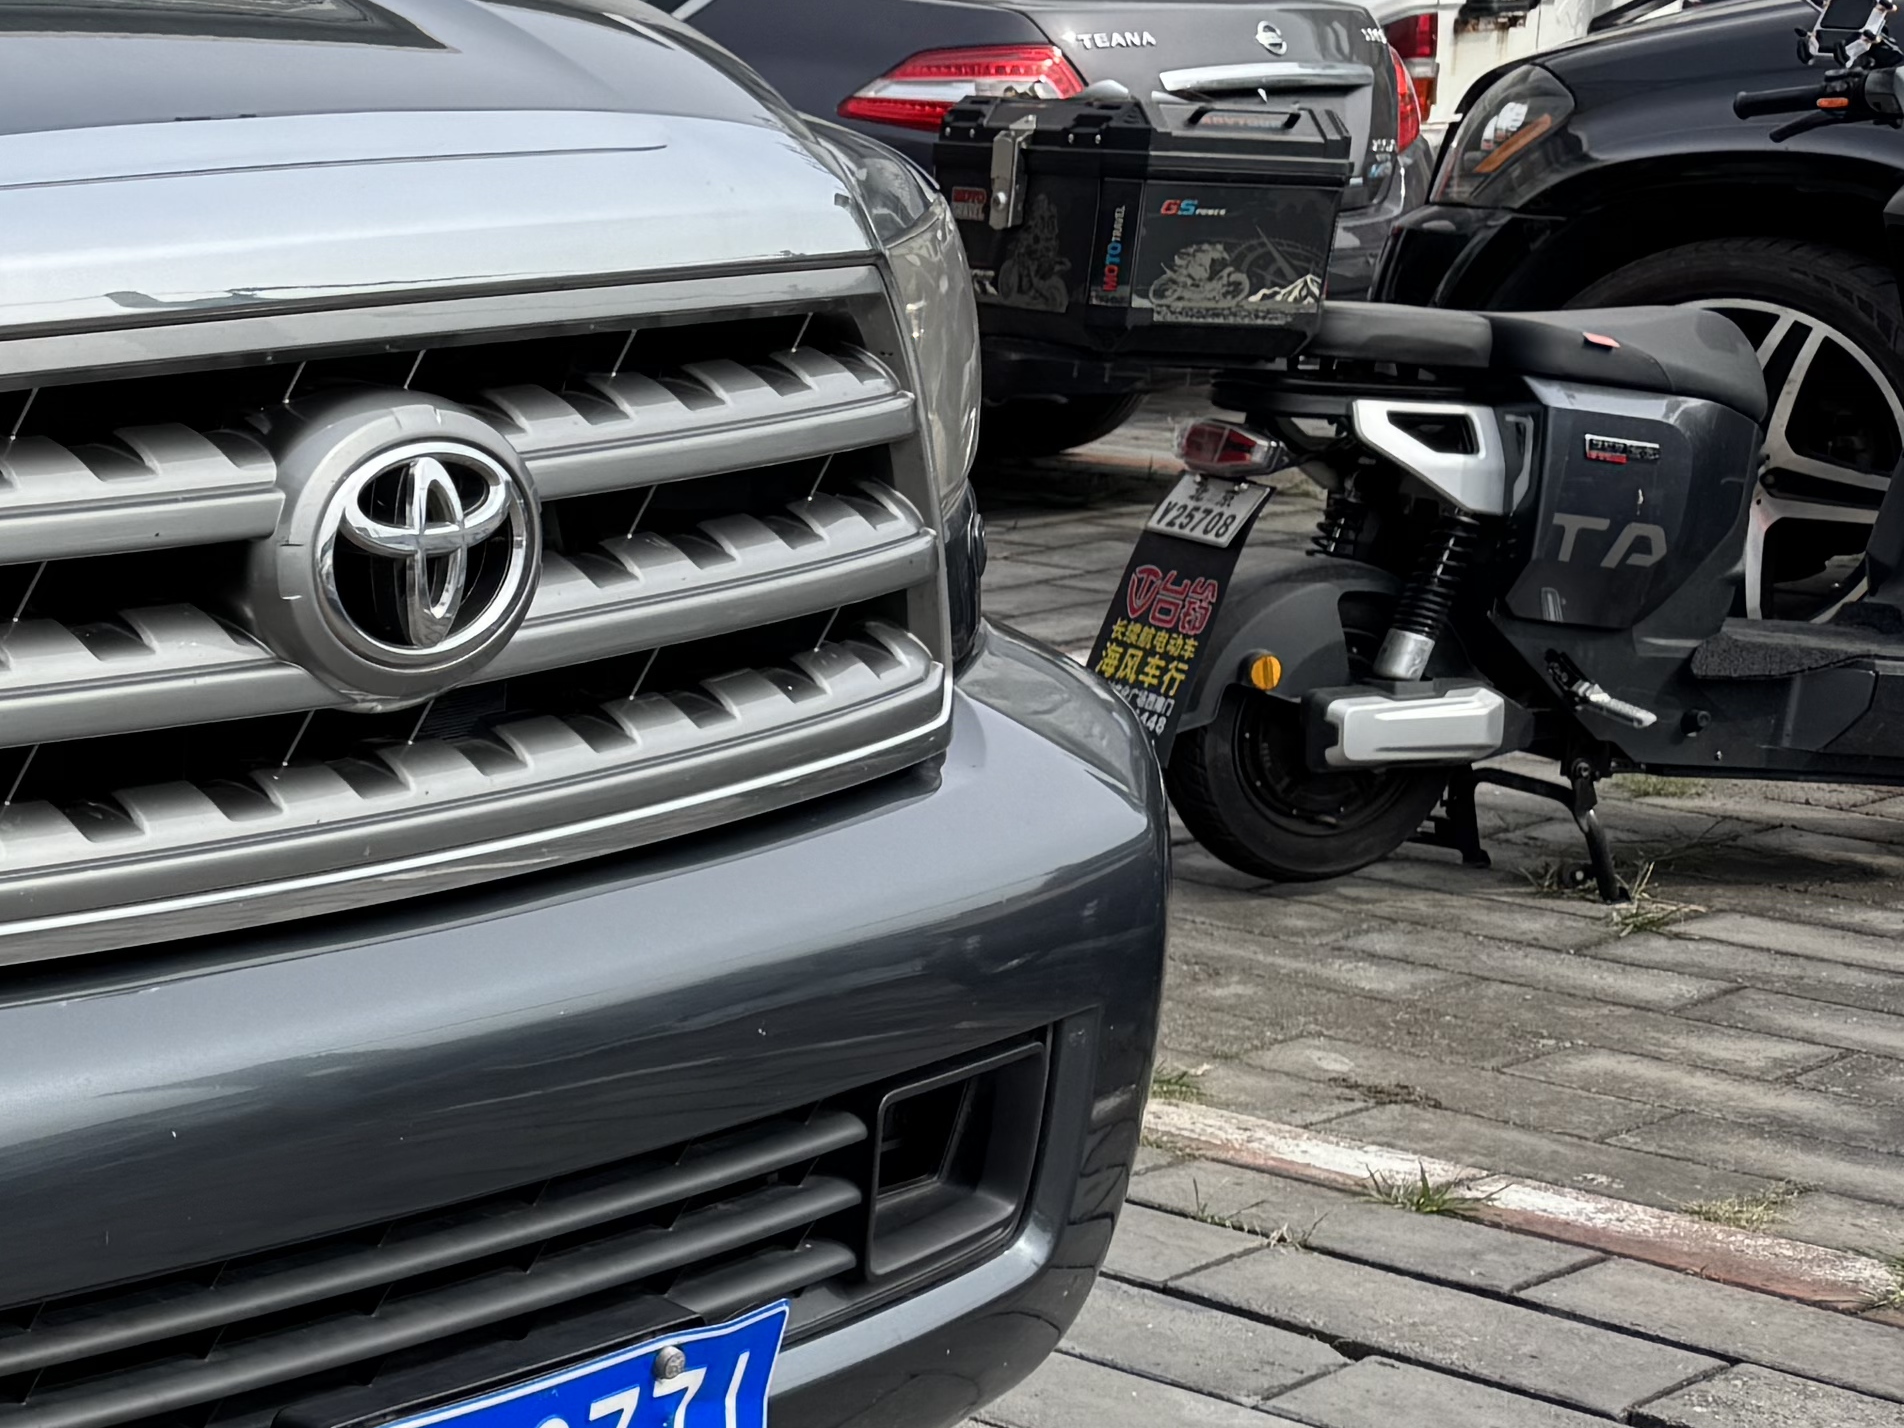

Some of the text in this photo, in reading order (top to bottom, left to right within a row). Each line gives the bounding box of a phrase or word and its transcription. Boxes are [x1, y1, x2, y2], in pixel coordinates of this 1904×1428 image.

[1078, 30, 1157, 50] TEANA
[1160, 199, 1198, 215] GS
[1096, 641, 1189, 697] 海风车行
